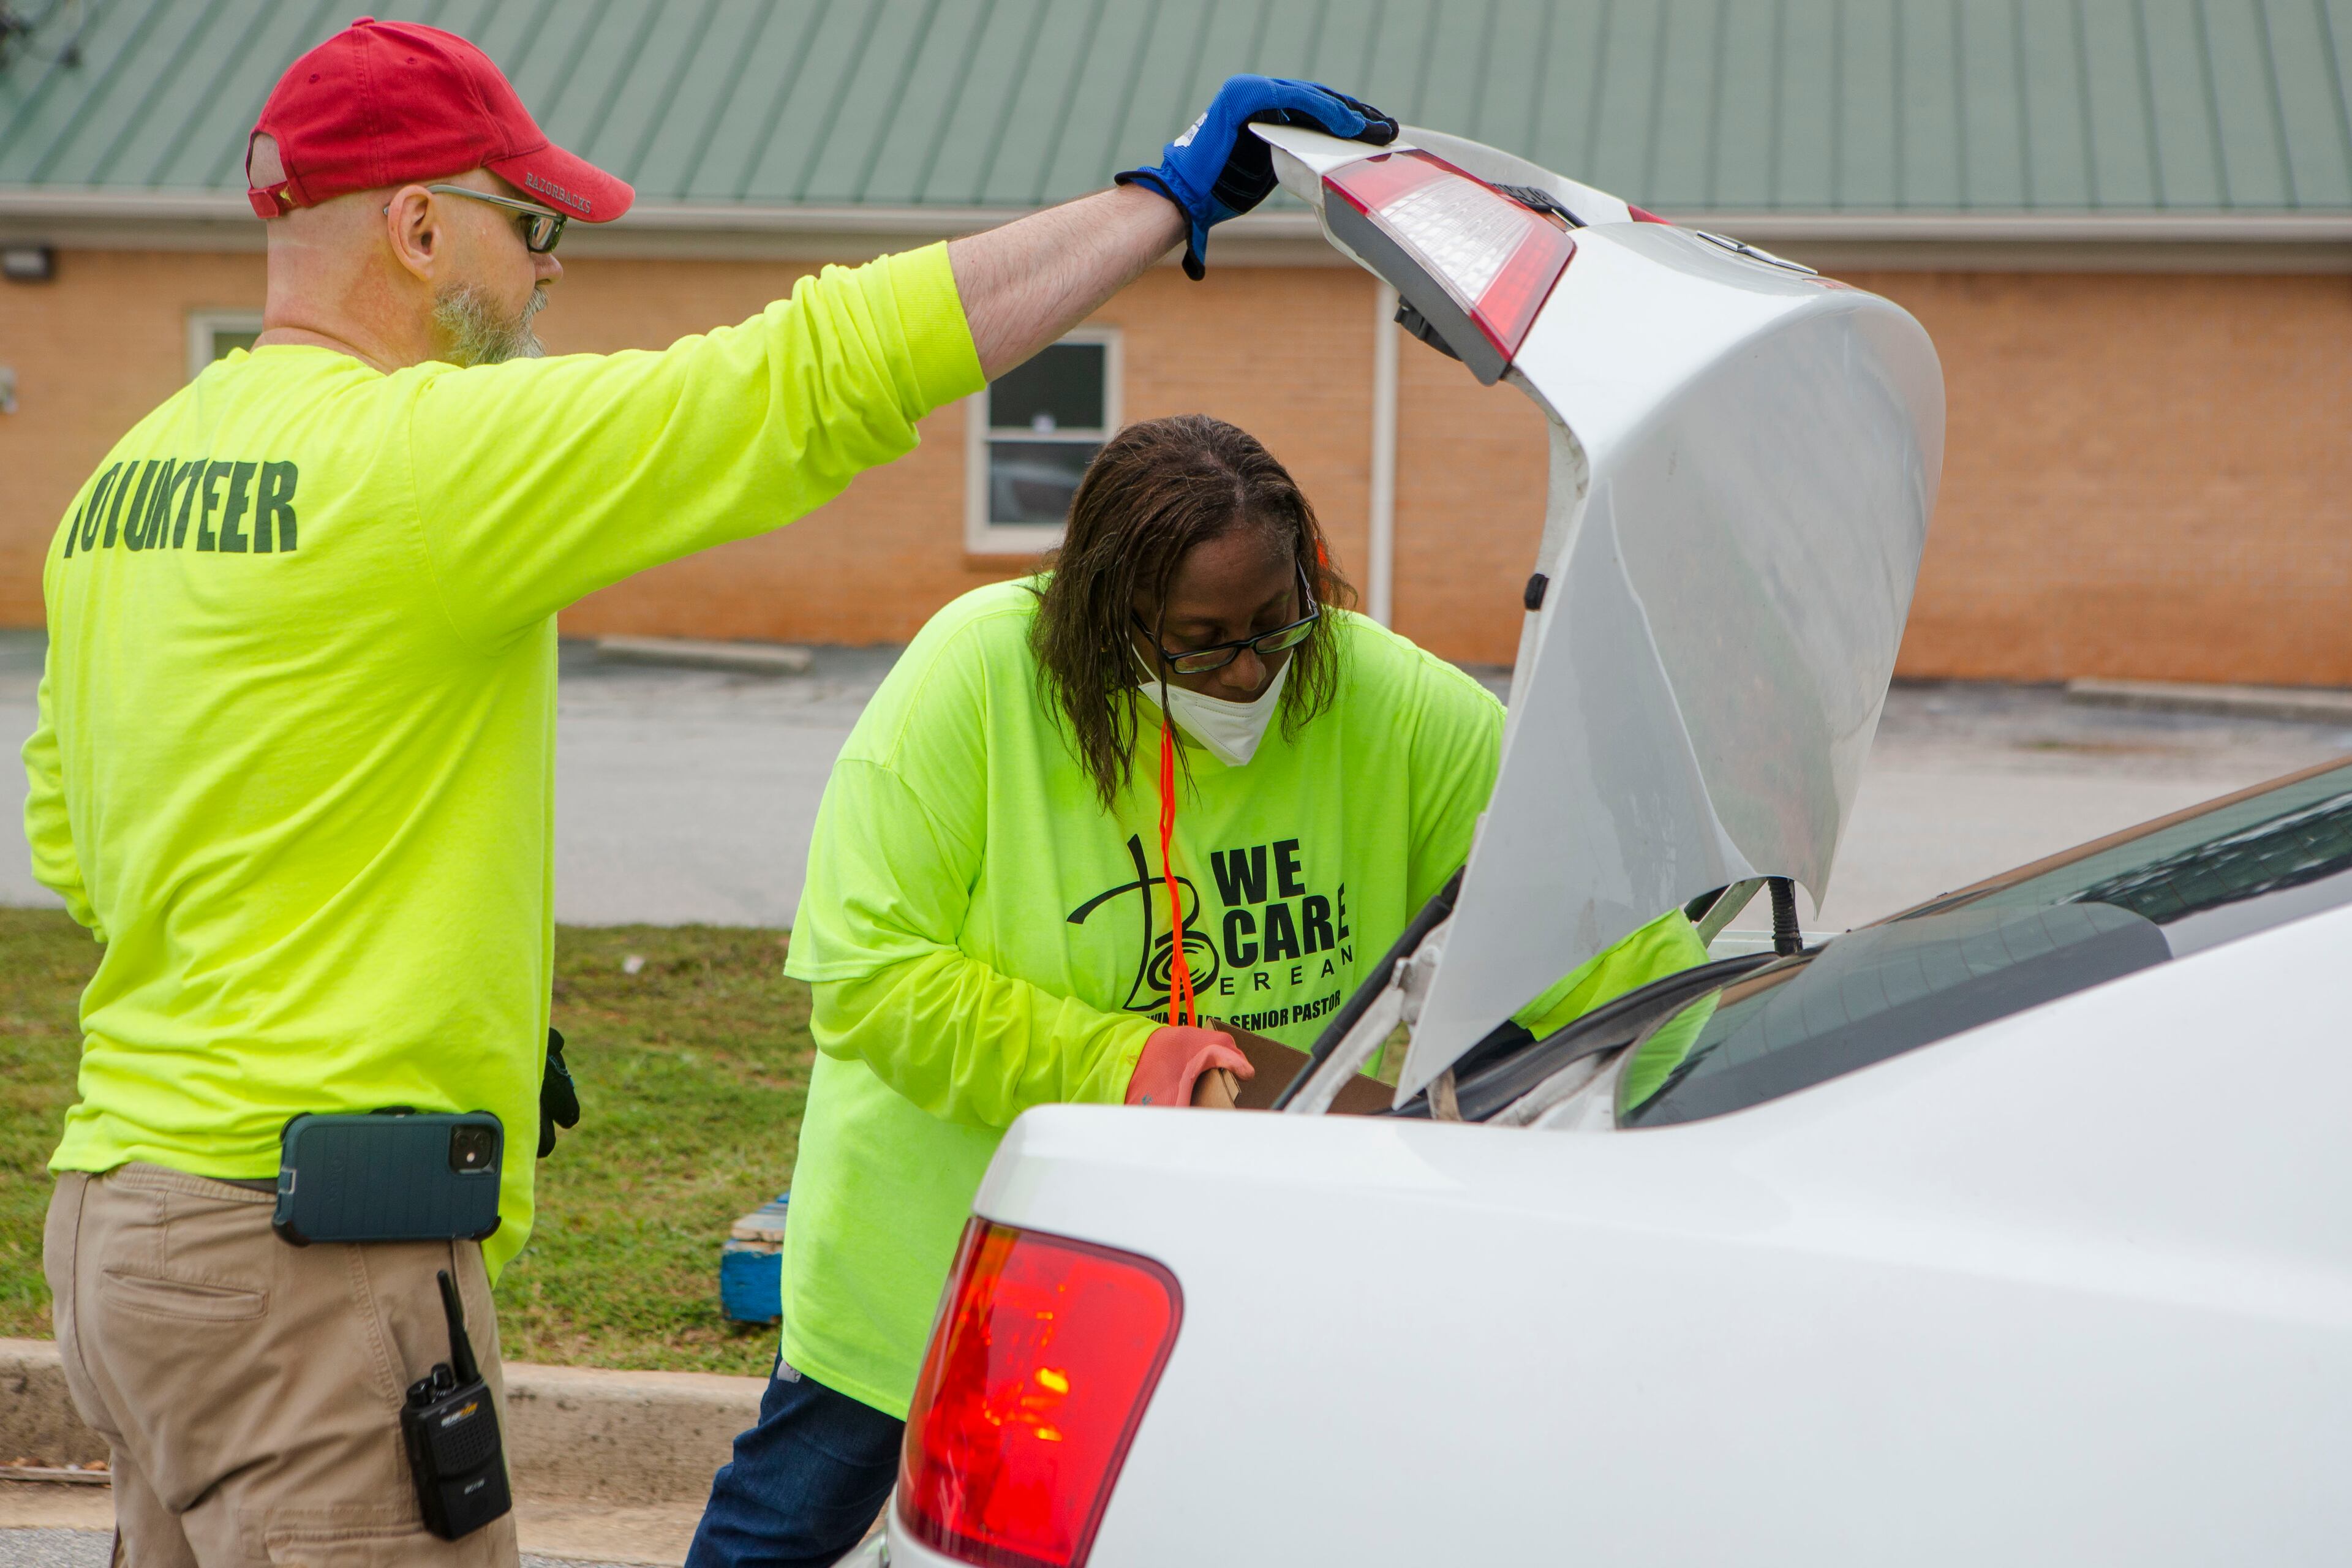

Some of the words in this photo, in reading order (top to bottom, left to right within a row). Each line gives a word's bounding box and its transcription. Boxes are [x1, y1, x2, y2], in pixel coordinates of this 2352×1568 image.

[525, 172, 592, 214] RAZORBACKS
[1210, 838, 1306, 907] WE
[1223, 882, 1350, 968] CARE
[1229, 1008, 1289, 1032] SENIOR
[1292, 989, 1341, 1023] PASTOR
